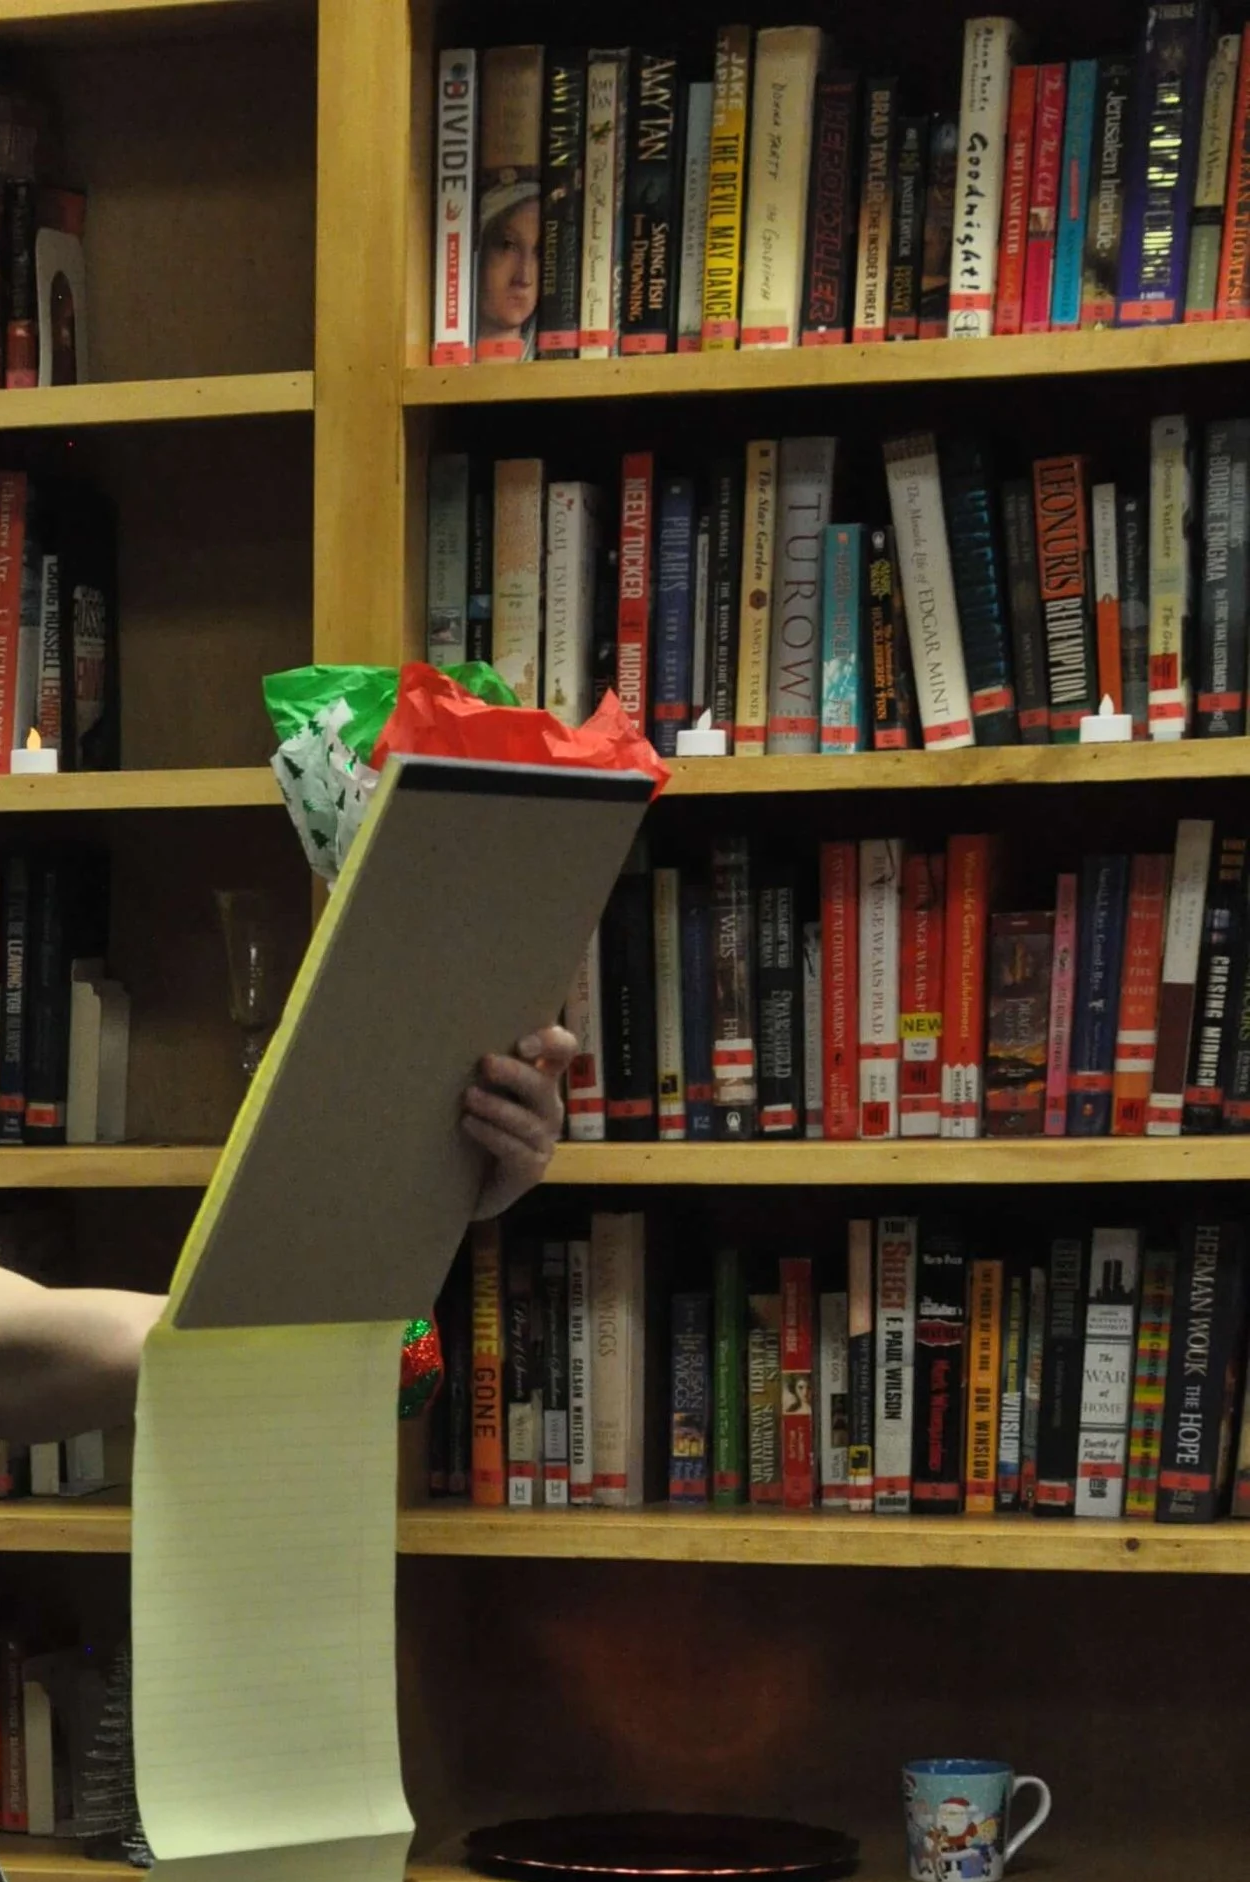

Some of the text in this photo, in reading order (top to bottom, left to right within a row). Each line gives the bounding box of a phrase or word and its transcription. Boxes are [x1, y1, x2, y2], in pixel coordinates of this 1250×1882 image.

[550, 67, 580, 167] AMY TAN
[638, 55, 677, 162] AMY TAN
[730, 51, 746, 110] JAKE
[864, 91, 890, 326] BRAD TAYLOR THE INSIDER THREAT
[1096, 92, 1127, 249] Jerusalem Interlude
[705, 134, 740, 321] THE DEVIL MAY DANCE
[957, 133, 989, 292] Goodnight!
[648, 278, 668, 309] FISH
[621, 477, 646, 599] NEELY TUCKER
[658, 515, 690, 592] POLARIS
[755, 469, 771, 580] The Star Garden
[1039, 462, 1082, 592] LEON URIS
[1205, 455, 1230, 583] BOURNE ENIGMA
[553, 511, 567, 667] GAIL TSUKIYAMA
[778, 493, 822, 701] TUROW
[918, 589, 940, 656] EDGAR
[1162, 606, 1174, 629] The
[619, 642, 642, 712] MURDER
[928, 661, 950, 716] MINT
[1046, 598, 1086, 704] REDEMPTION
[749, 673, 760, 718] TURNER
[962, 851, 977, 884] When
[719, 914, 737, 960] WEIS
[870, 931, 886, 988] WEARS
[5, 939, 24, 1015] LEAVING YOU
[913, 954, 928, 1000] WEARS
[1204, 955, 1231, 1019] CHASING
[832, 987, 845, 1049] MARMONT
[903, 1019, 943, 1035] NEW
[474, 1270, 498, 1439] WHITE GONE
[600, 1299, 617, 1357] WIGGS
[881, 1239, 912, 1420] SELECT F. PAUL WILSON
[1175, 1224, 1221, 1465] HERMAN WOUK THE HOPE
[572, 1358, 583, 1466] COLSON WHITEHEAD
[675, 1353, 704, 1410] SUSAN WIGGS
[1084, 1370, 1127, 1384] WAR
[973, 1386, 993, 1480] DON WINSLOW
[1000, 1392, 1021, 1465] WINSLOW
